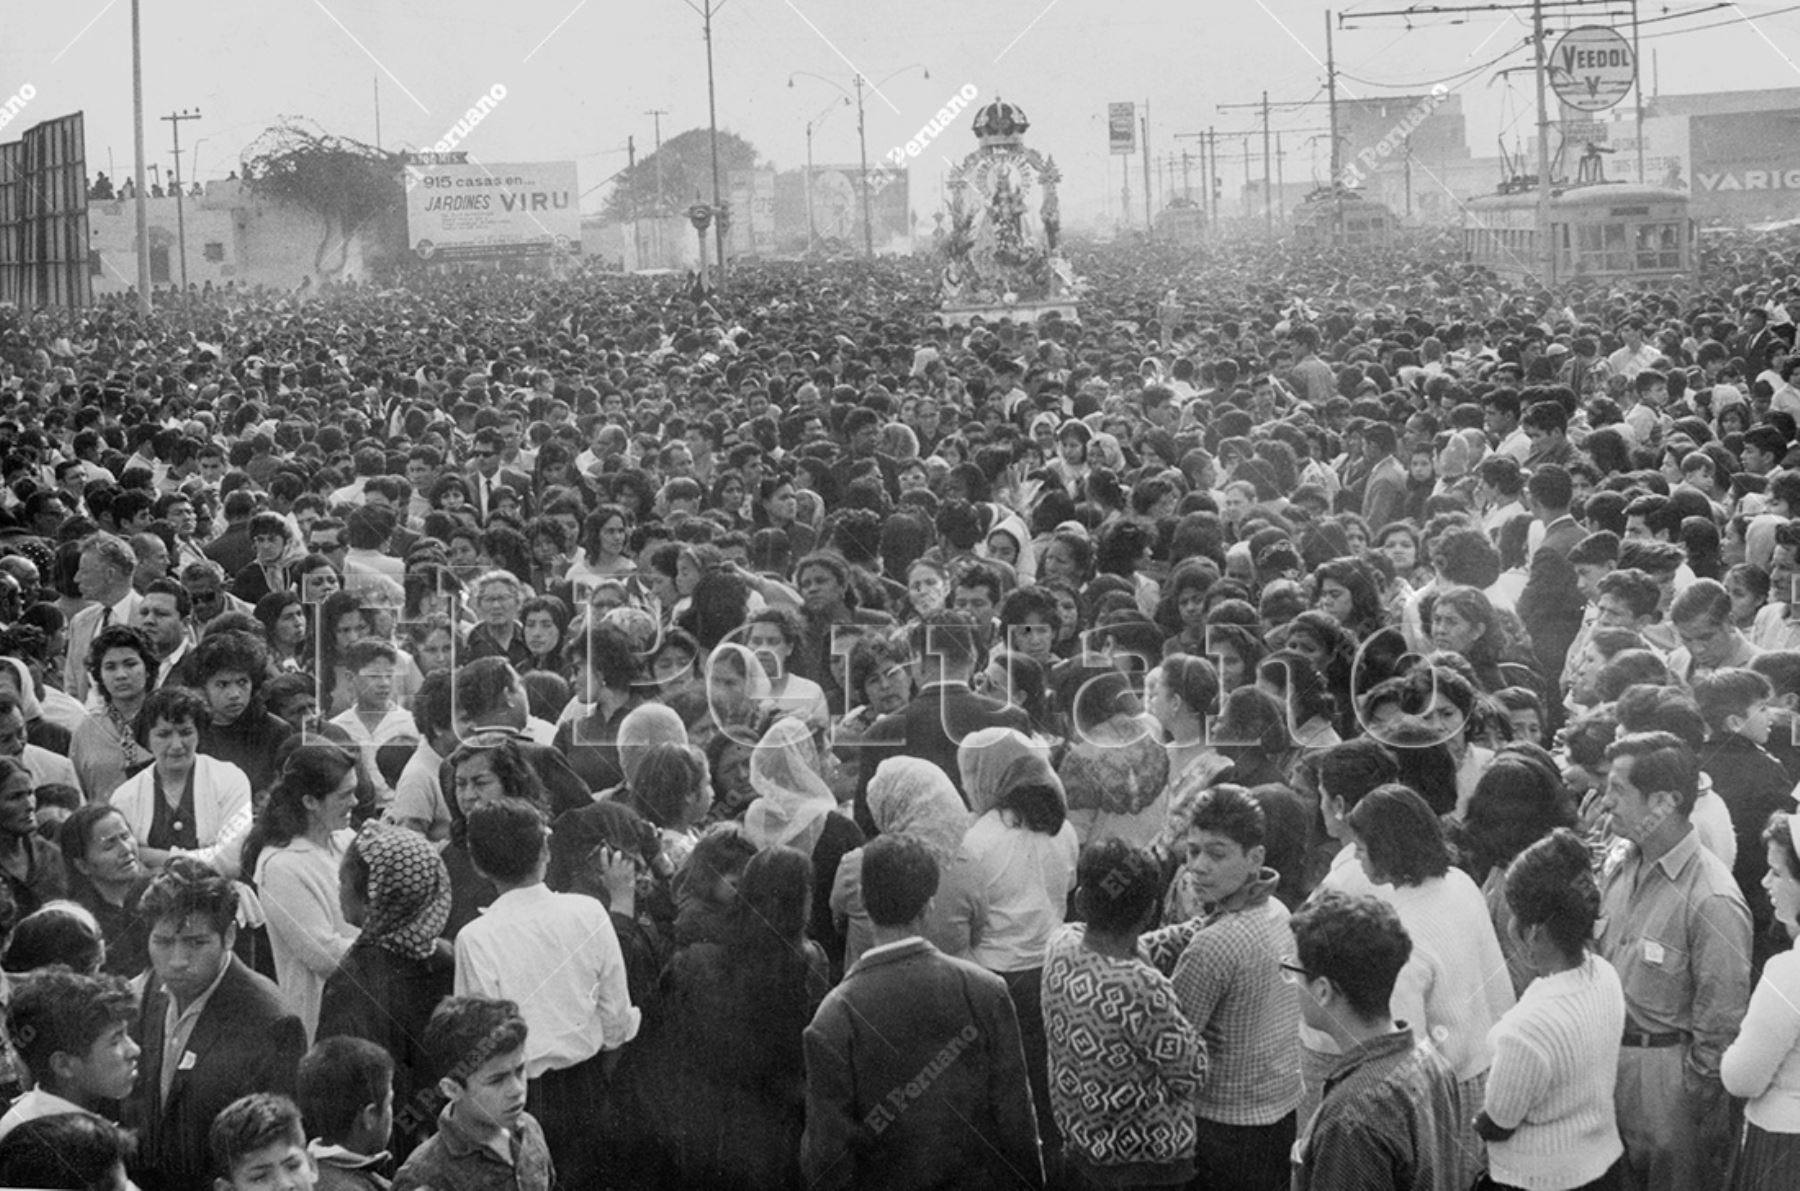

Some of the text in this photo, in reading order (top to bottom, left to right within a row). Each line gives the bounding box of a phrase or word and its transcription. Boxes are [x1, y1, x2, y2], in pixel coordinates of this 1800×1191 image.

[1561, 45, 1630, 75] VEEDOL
[423, 175, 452, 188] 915
[455, 177, 502, 188] casas
[424, 191, 569, 212] JARDINES VIRU
